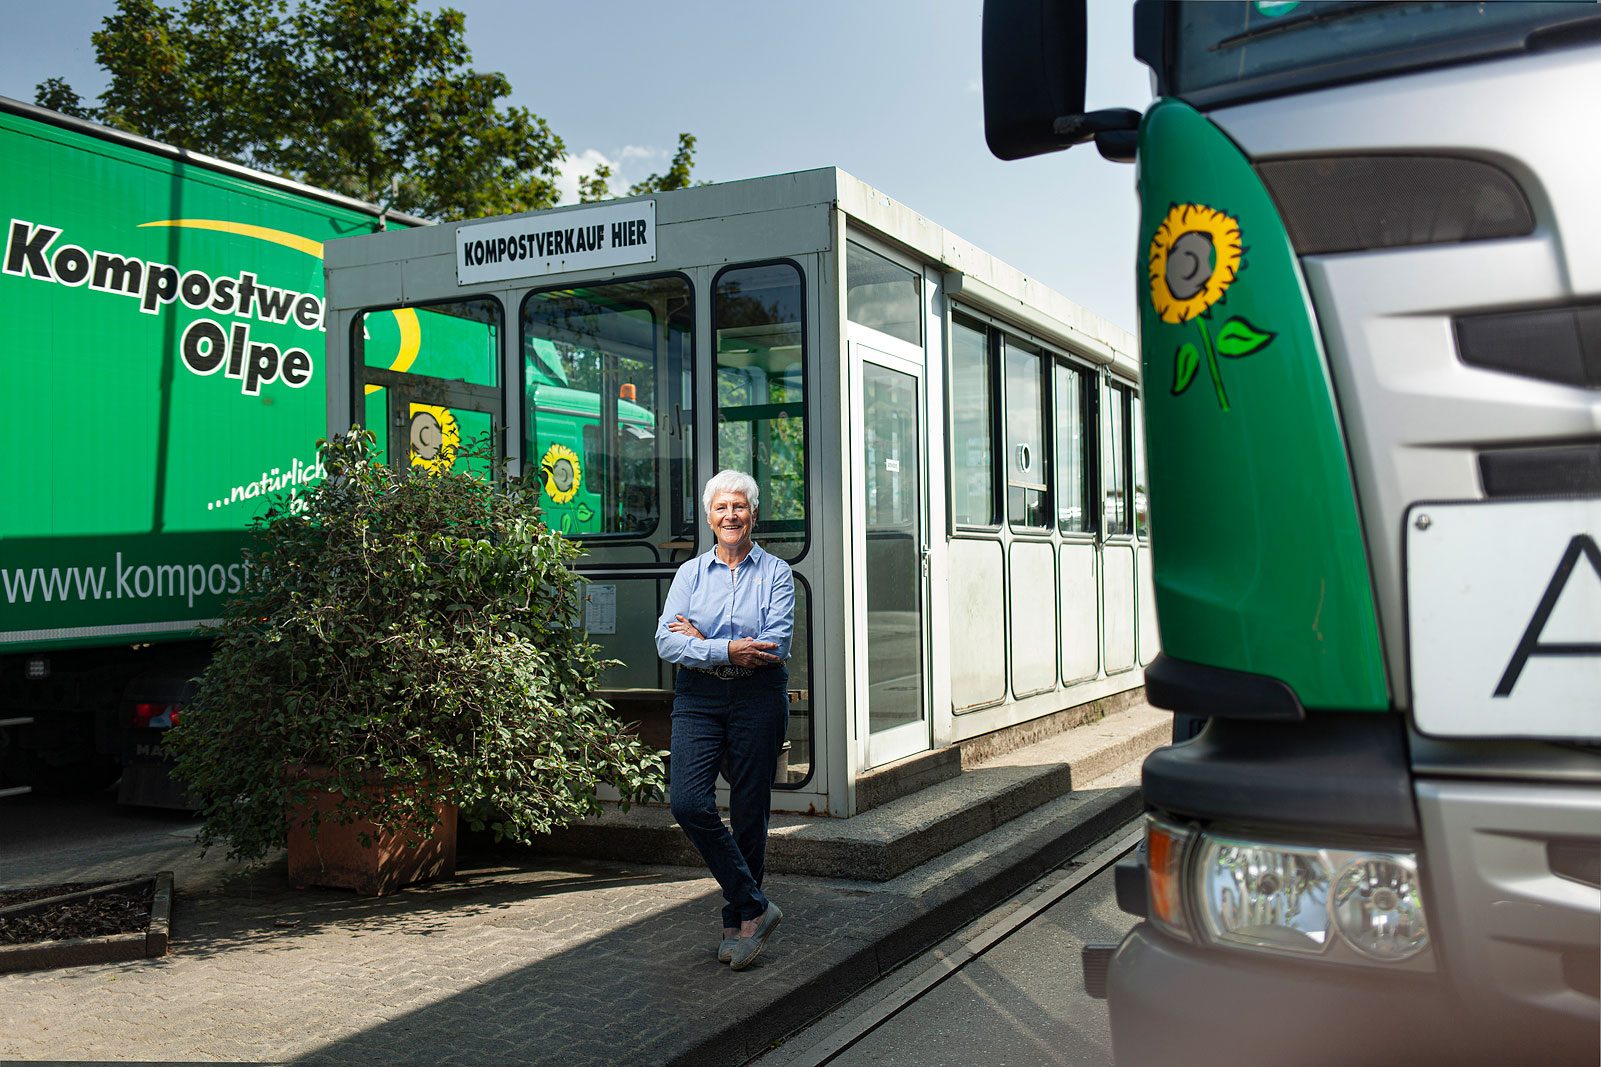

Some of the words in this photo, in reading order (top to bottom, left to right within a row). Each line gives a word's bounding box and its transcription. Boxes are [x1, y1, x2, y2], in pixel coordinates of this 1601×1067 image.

[2, 218, 327, 332] Kompostwe
[464, 224, 605, 267] KOMPOSTVERKAUF
[611, 219, 648, 248] HIER
[180, 318, 313, 396] Olpe
[1, 551, 254, 608] www.kompost
[1491, 533, 1601, 698] A
